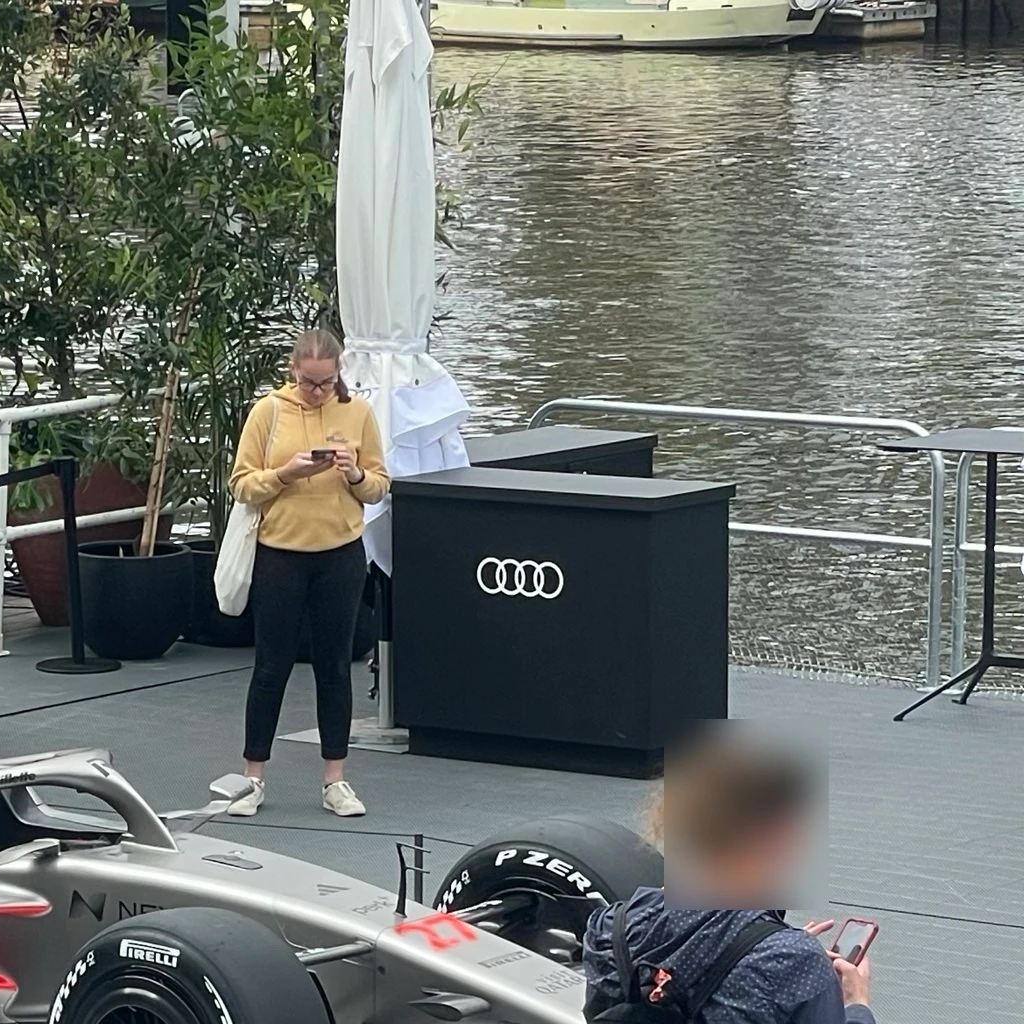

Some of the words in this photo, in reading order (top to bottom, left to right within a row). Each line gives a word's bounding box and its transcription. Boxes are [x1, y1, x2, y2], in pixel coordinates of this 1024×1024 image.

[494, 849, 518, 867] P
[393, 911, 478, 952] 27
[119, 938, 181, 968] PIRELLI
[477, 950, 533, 969] PIRELLI
